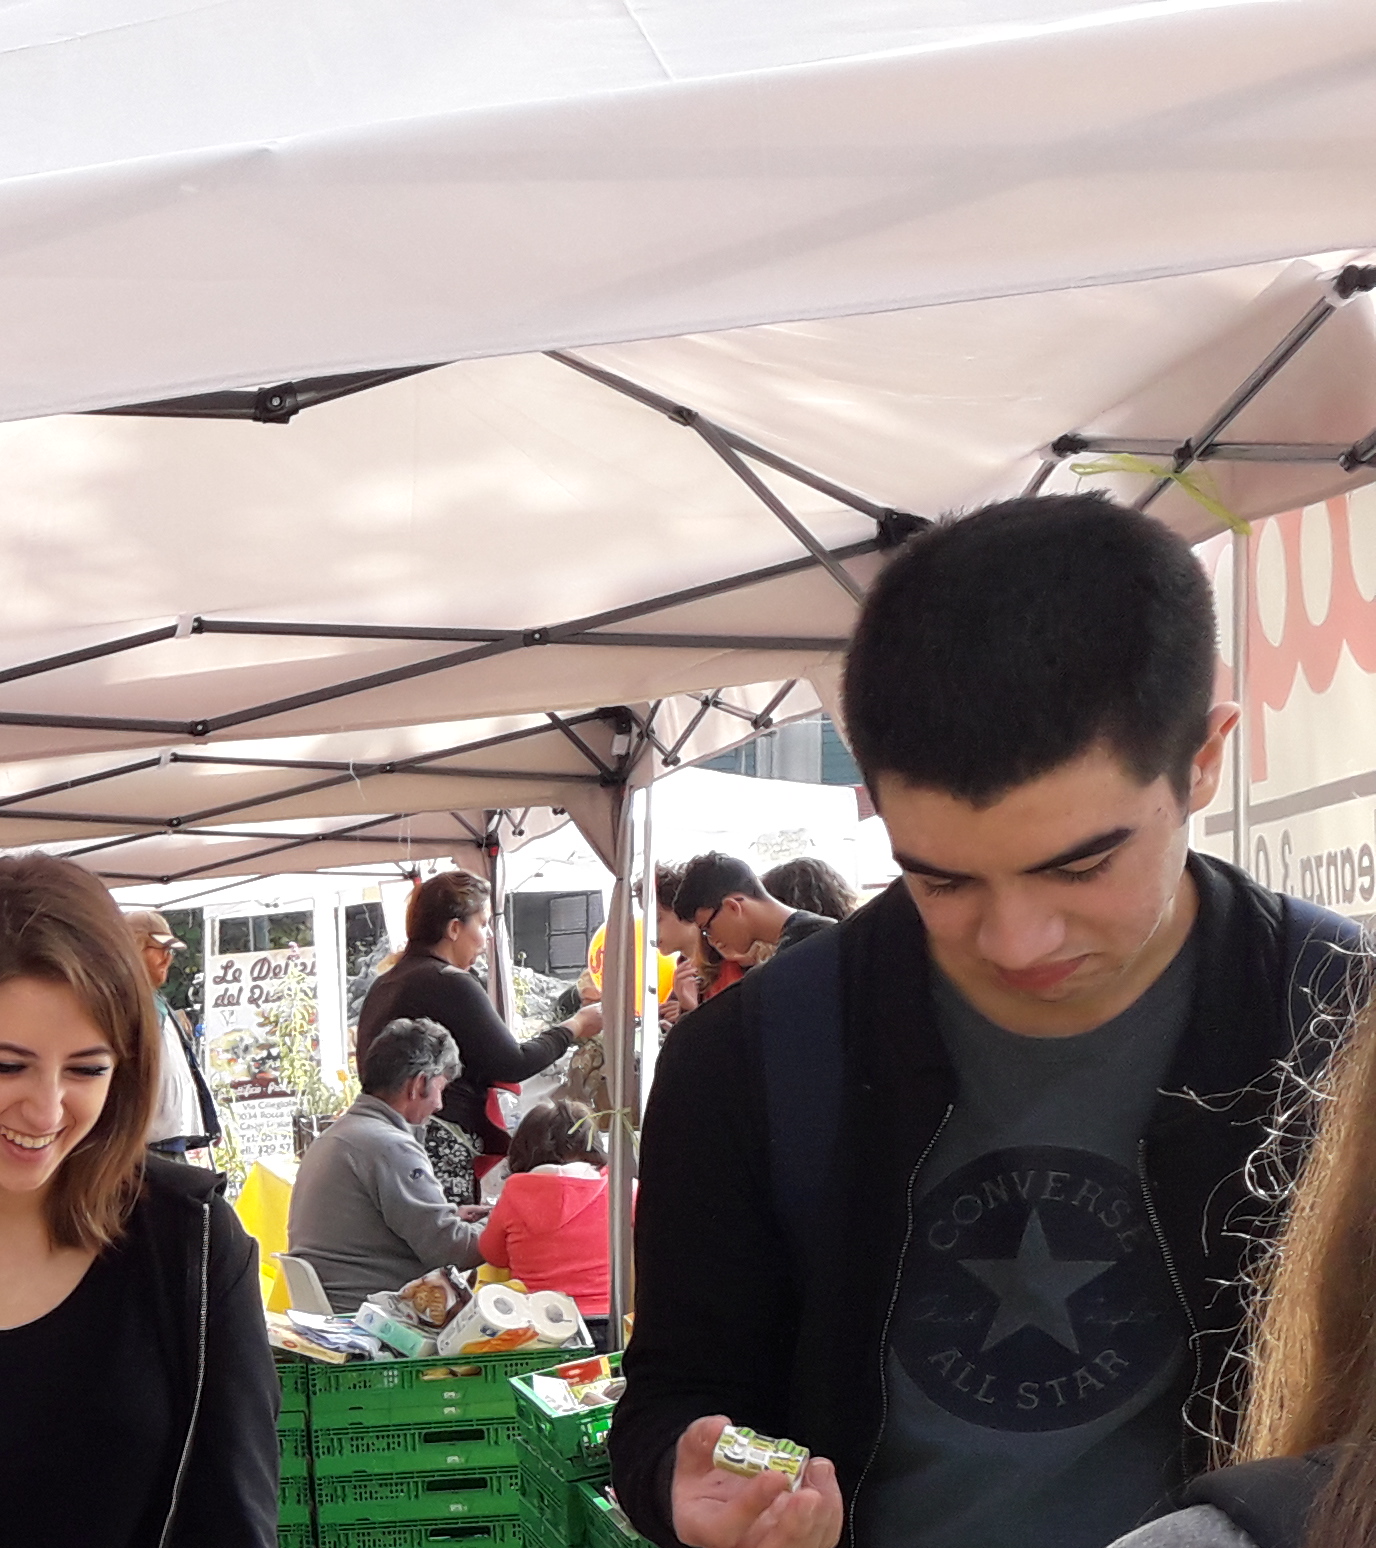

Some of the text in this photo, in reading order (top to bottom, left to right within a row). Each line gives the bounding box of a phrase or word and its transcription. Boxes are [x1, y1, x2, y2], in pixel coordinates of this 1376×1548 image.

[212, 959, 243, 985] Le
[212, 985, 244, 1008] del
[927, 1345, 1131, 1411] ALL STAR
